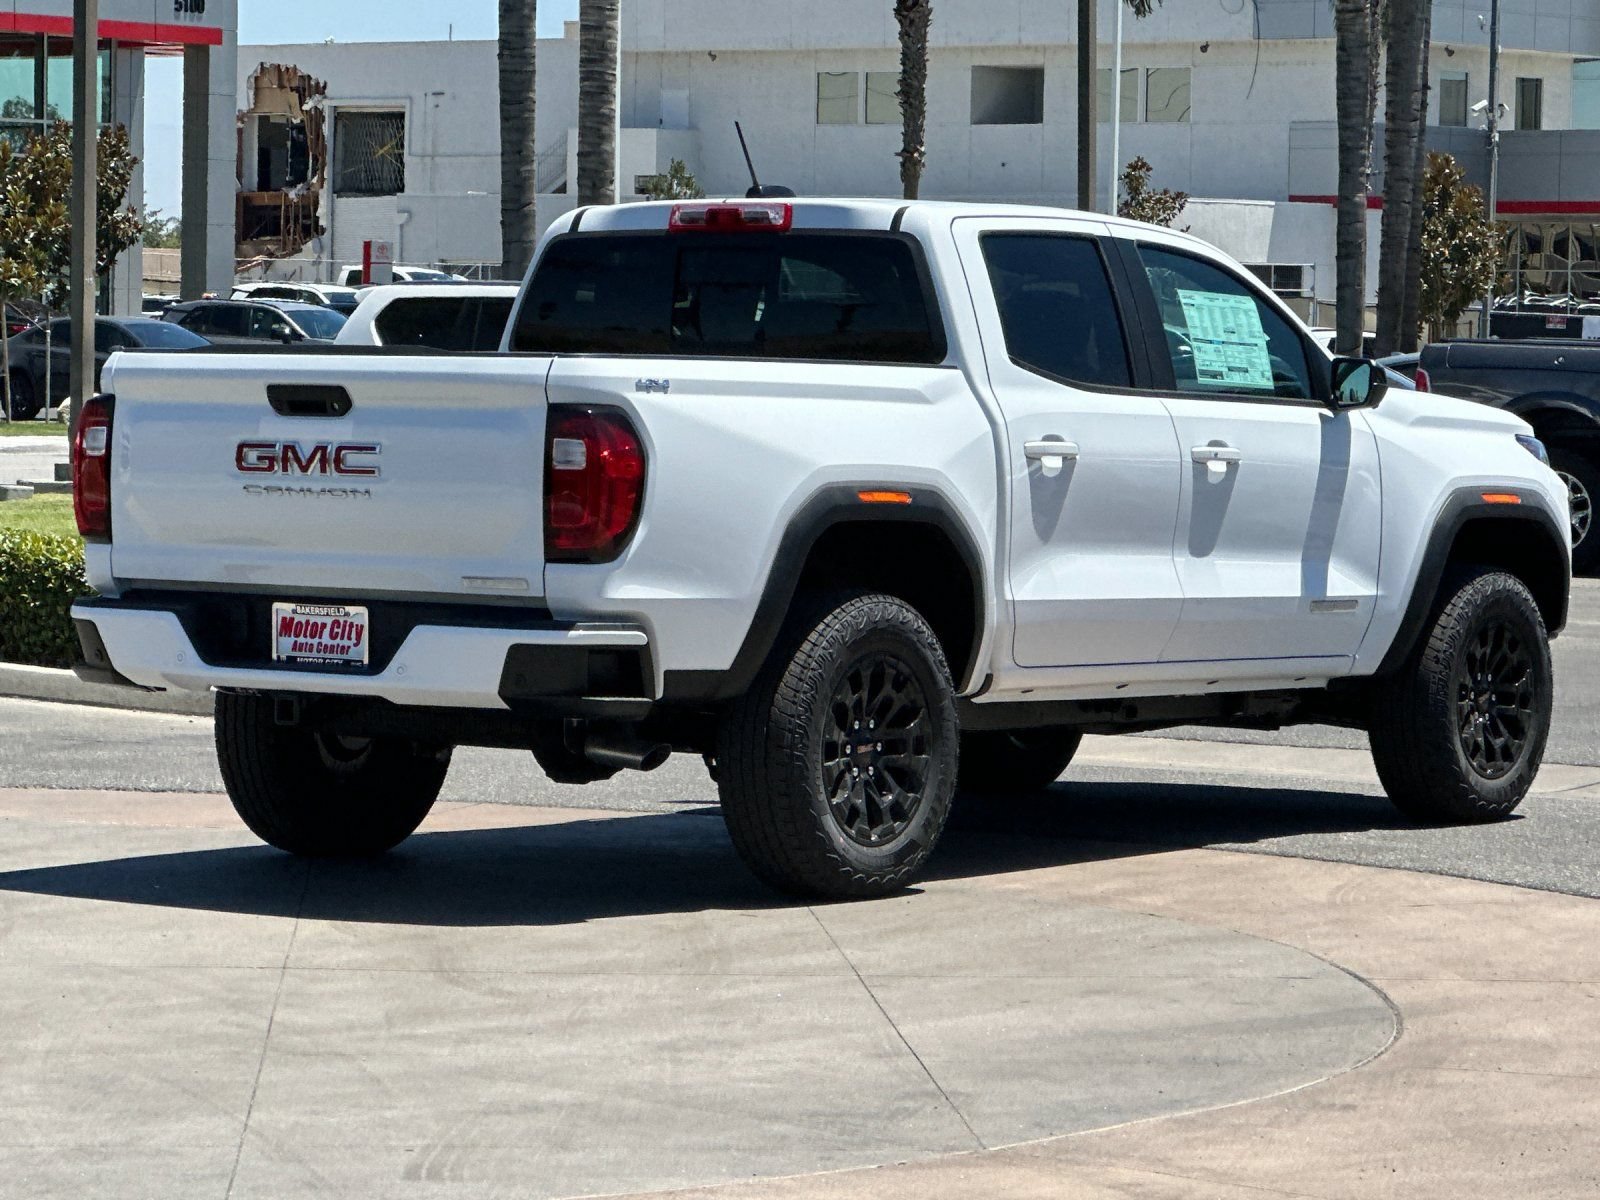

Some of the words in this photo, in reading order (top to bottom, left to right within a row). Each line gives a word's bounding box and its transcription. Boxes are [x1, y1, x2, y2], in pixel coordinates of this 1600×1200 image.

[235, 440, 380, 477] GMC
[243, 484, 372, 499] CANYON
[296, 605, 346, 616] BAKERSFIELD
[279, 616, 327, 639] Motor
[329, 618, 364, 647] City
[291, 640, 314, 653] Auto
[316, 641, 351, 655] Center
